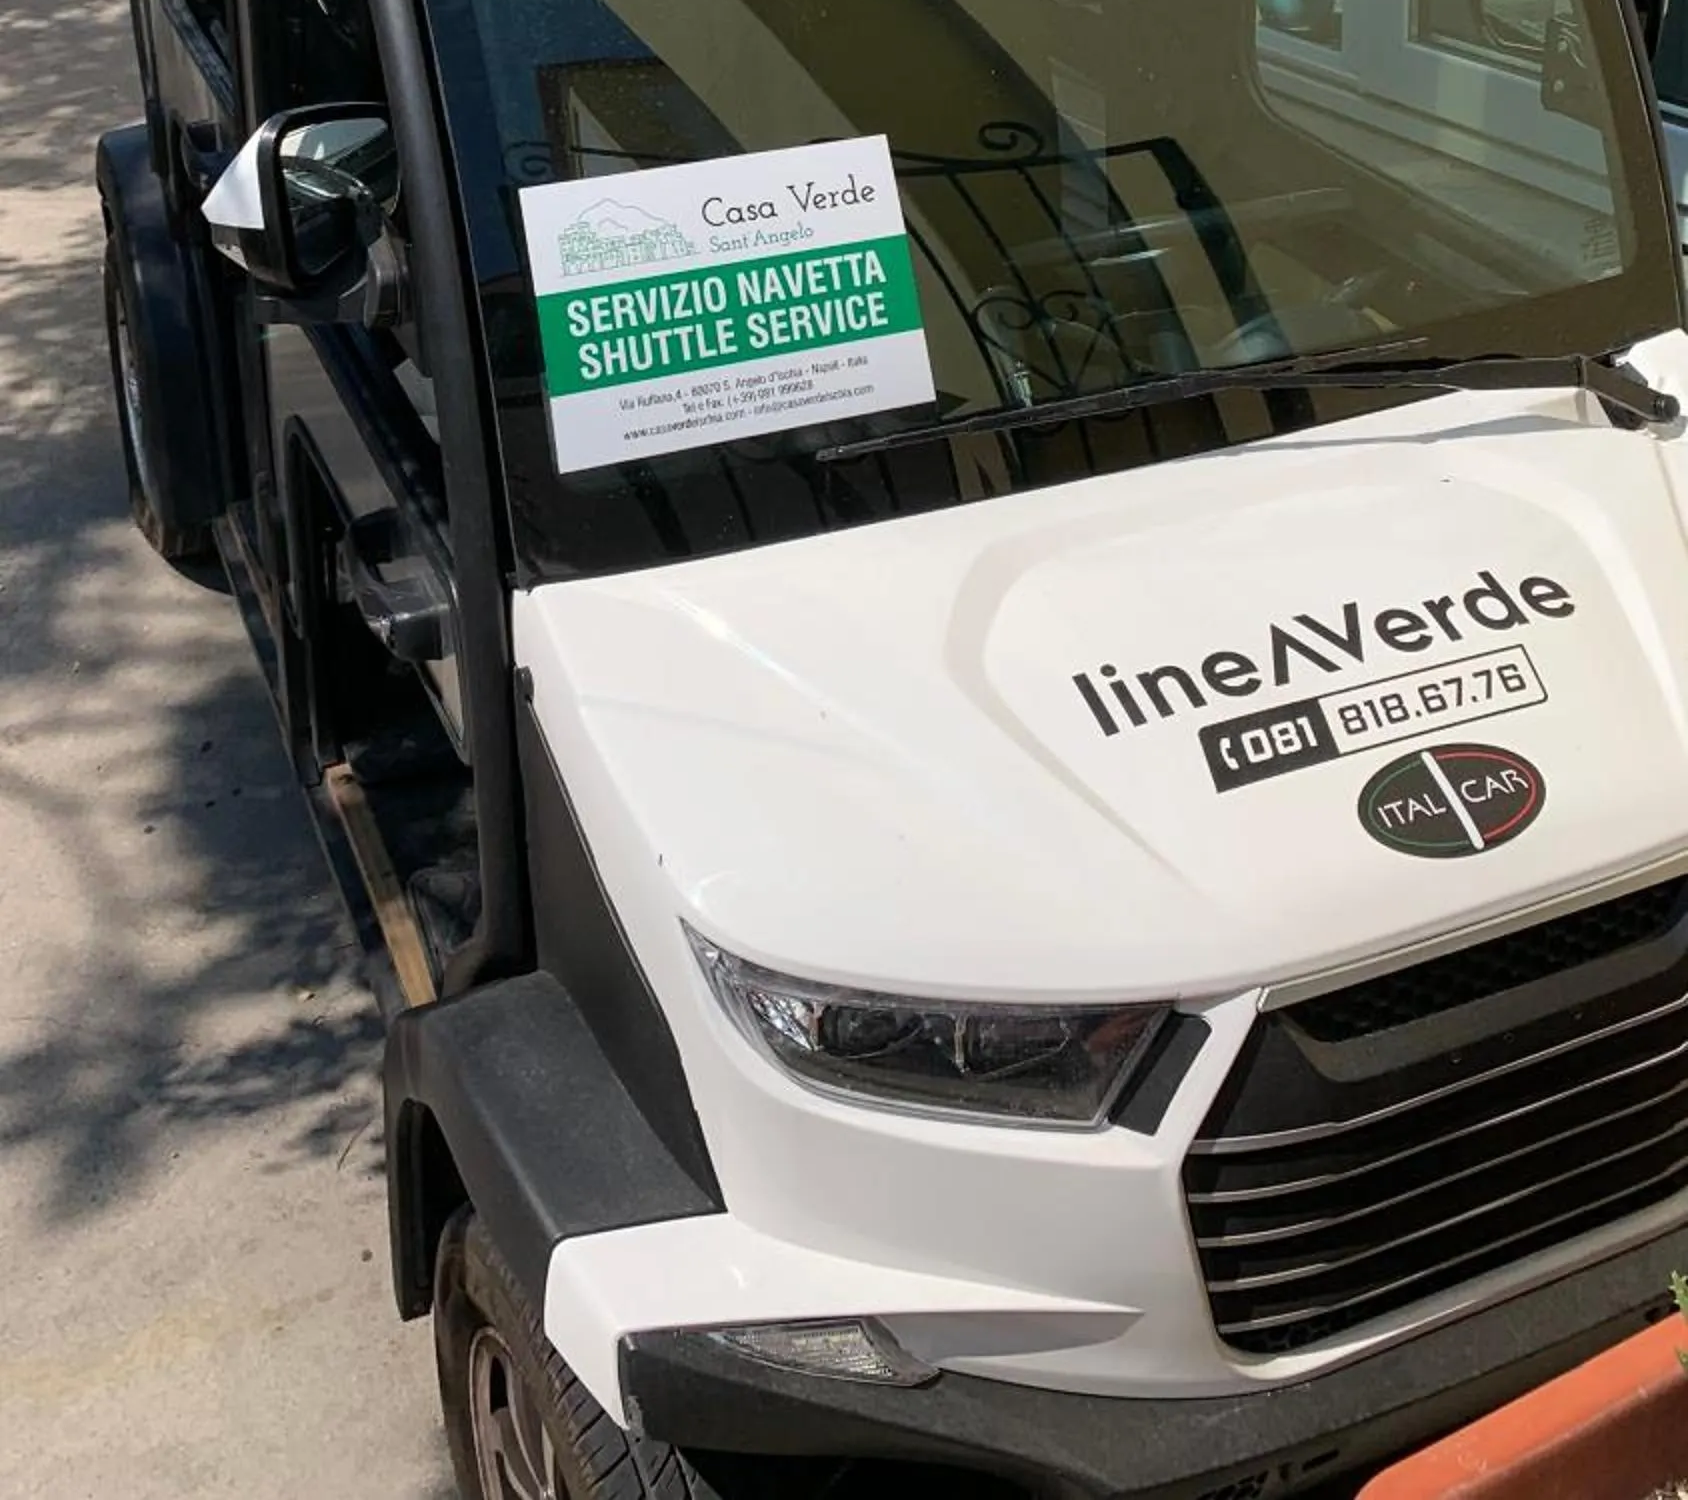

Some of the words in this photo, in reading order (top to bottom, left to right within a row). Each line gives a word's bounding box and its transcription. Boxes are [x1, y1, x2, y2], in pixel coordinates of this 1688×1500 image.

[702, 197, 778, 227] Casa
[786, 174, 875, 212] Verde
[568, 277, 726, 336] SERVIZIO
[737, 250, 886, 306] NAVETTA
[579, 318, 737, 379] SHUTTLE
[747, 292, 888, 348] SERVICE
[1241, 717, 1317, 762] 081
[1338, 664, 1526, 735] 818.67.76
[1378, 791, 1448, 828] ITAL
[1461, 770, 1528, 802] CAR
